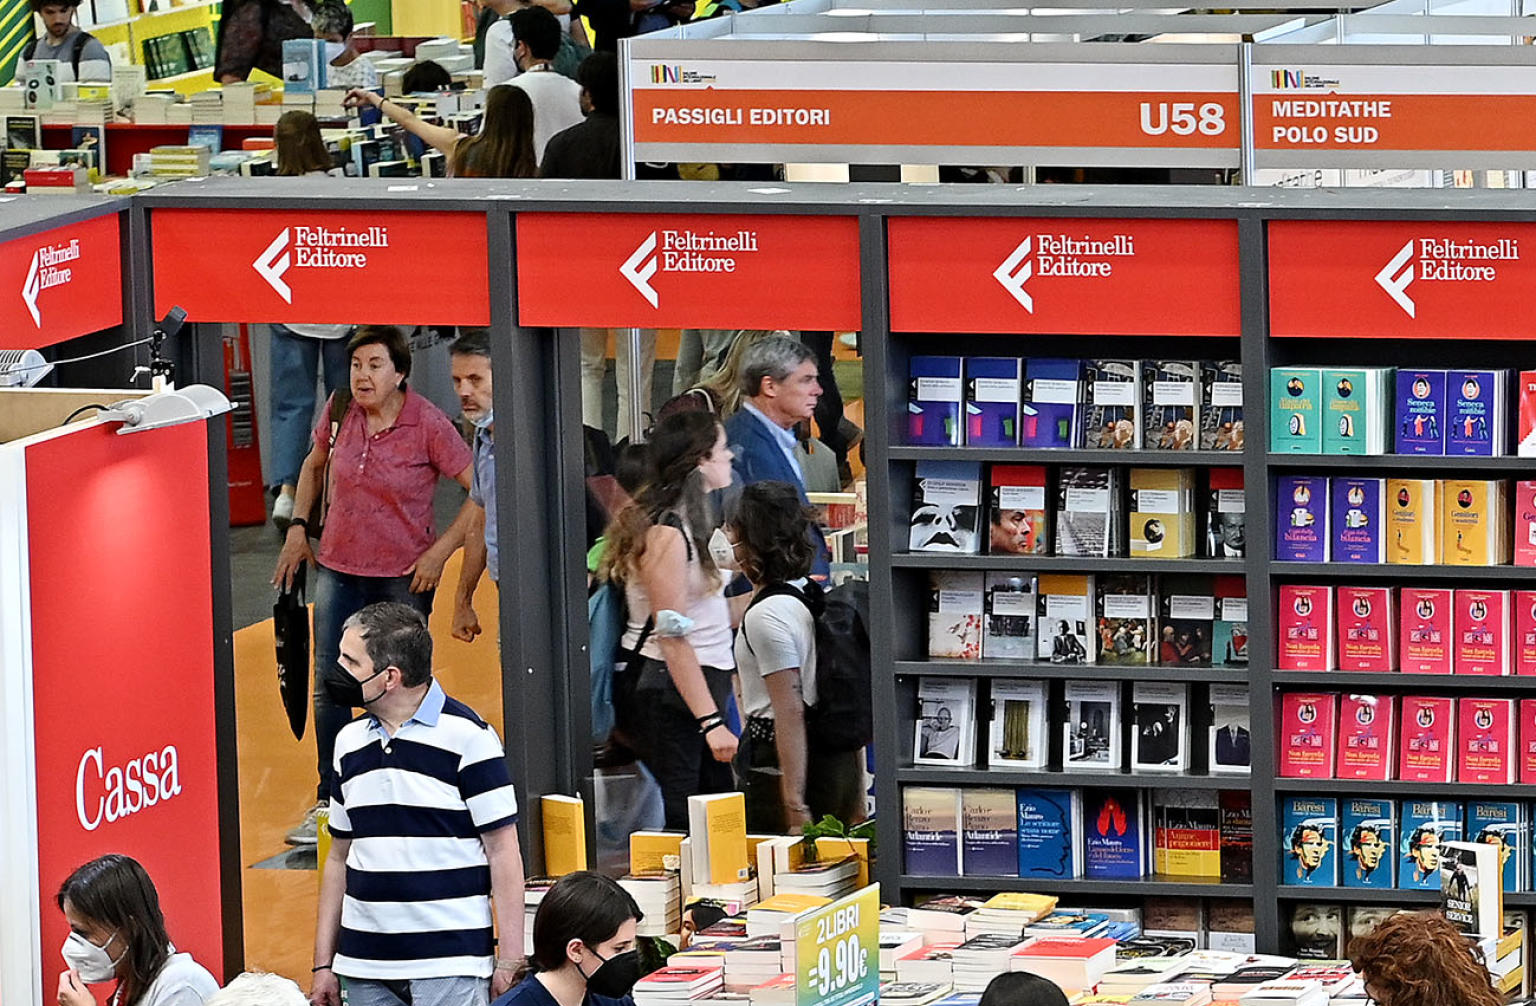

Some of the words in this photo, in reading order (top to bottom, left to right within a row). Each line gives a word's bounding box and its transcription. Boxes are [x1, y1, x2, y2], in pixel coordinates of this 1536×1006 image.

[652, 108, 742, 126] PASSIGLI
[750, 108, 830, 126] EDITORI
[1139, 102, 1225, 136] U58
[1272, 101, 1391, 117] MEDITATHE
[1273, 127, 1327, 143] POLO
[1334, 127, 1379, 143] SUD
[295, 226, 388, 249] Feltrinelli
[662, 229, 758, 253] Feltrinelli
[1037, 234, 1134, 257] Feltrinelli
[39, 238, 80, 265] Feltrinelli
[295, 247, 366, 268] Editore
[663, 250, 735, 272] Editore
[1420, 238, 1518, 261] Feltrinelli
[39, 265, 72, 290] Editore
[1037, 256, 1111, 278] Editore
[1420, 260, 1496, 282] Editore
[76, 744, 182, 831] Cassa
[817, 918, 825, 945] 2
[825, 903, 859, 940] LIBRI
